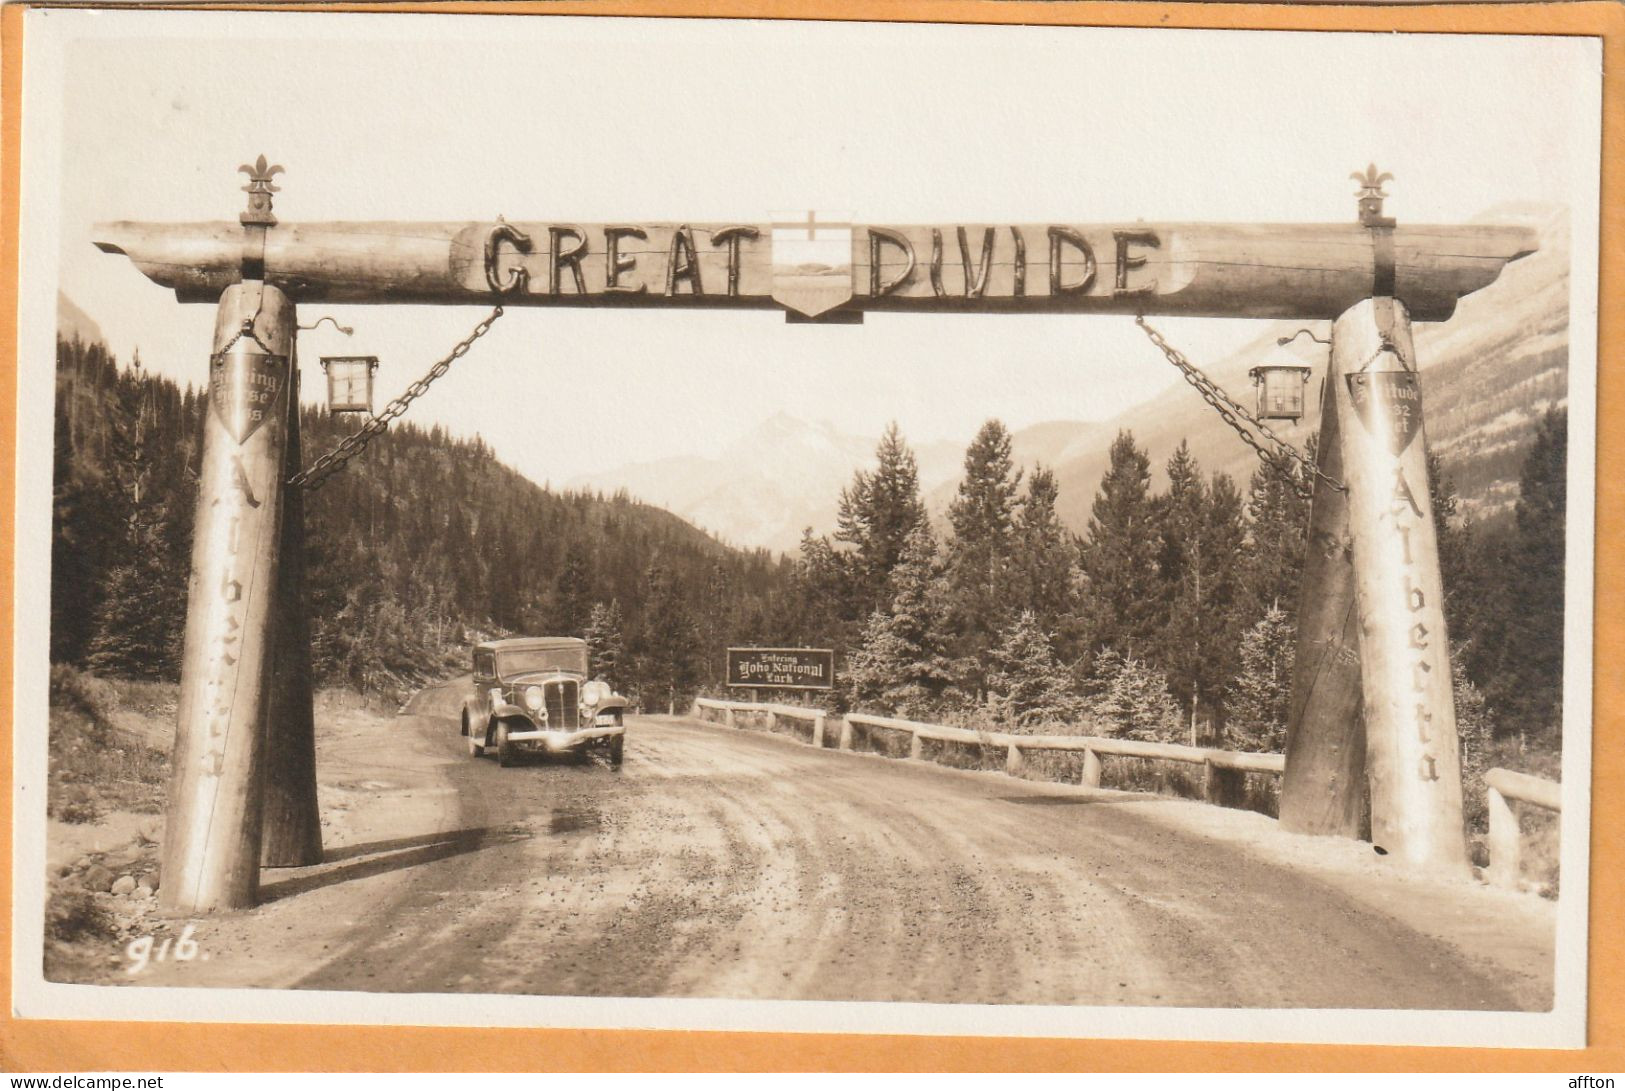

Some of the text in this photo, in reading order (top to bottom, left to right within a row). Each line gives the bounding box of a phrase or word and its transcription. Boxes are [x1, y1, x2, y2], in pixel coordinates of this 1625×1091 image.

[484, 223, 1161, 298] GREAT DIVIDE
[1379, 466, 1440, 783] Alberta
[761, 653, 798, 665] Entering
[739, 661, 823, 679] Yoho National
[766, 672, 794, 684] Park
